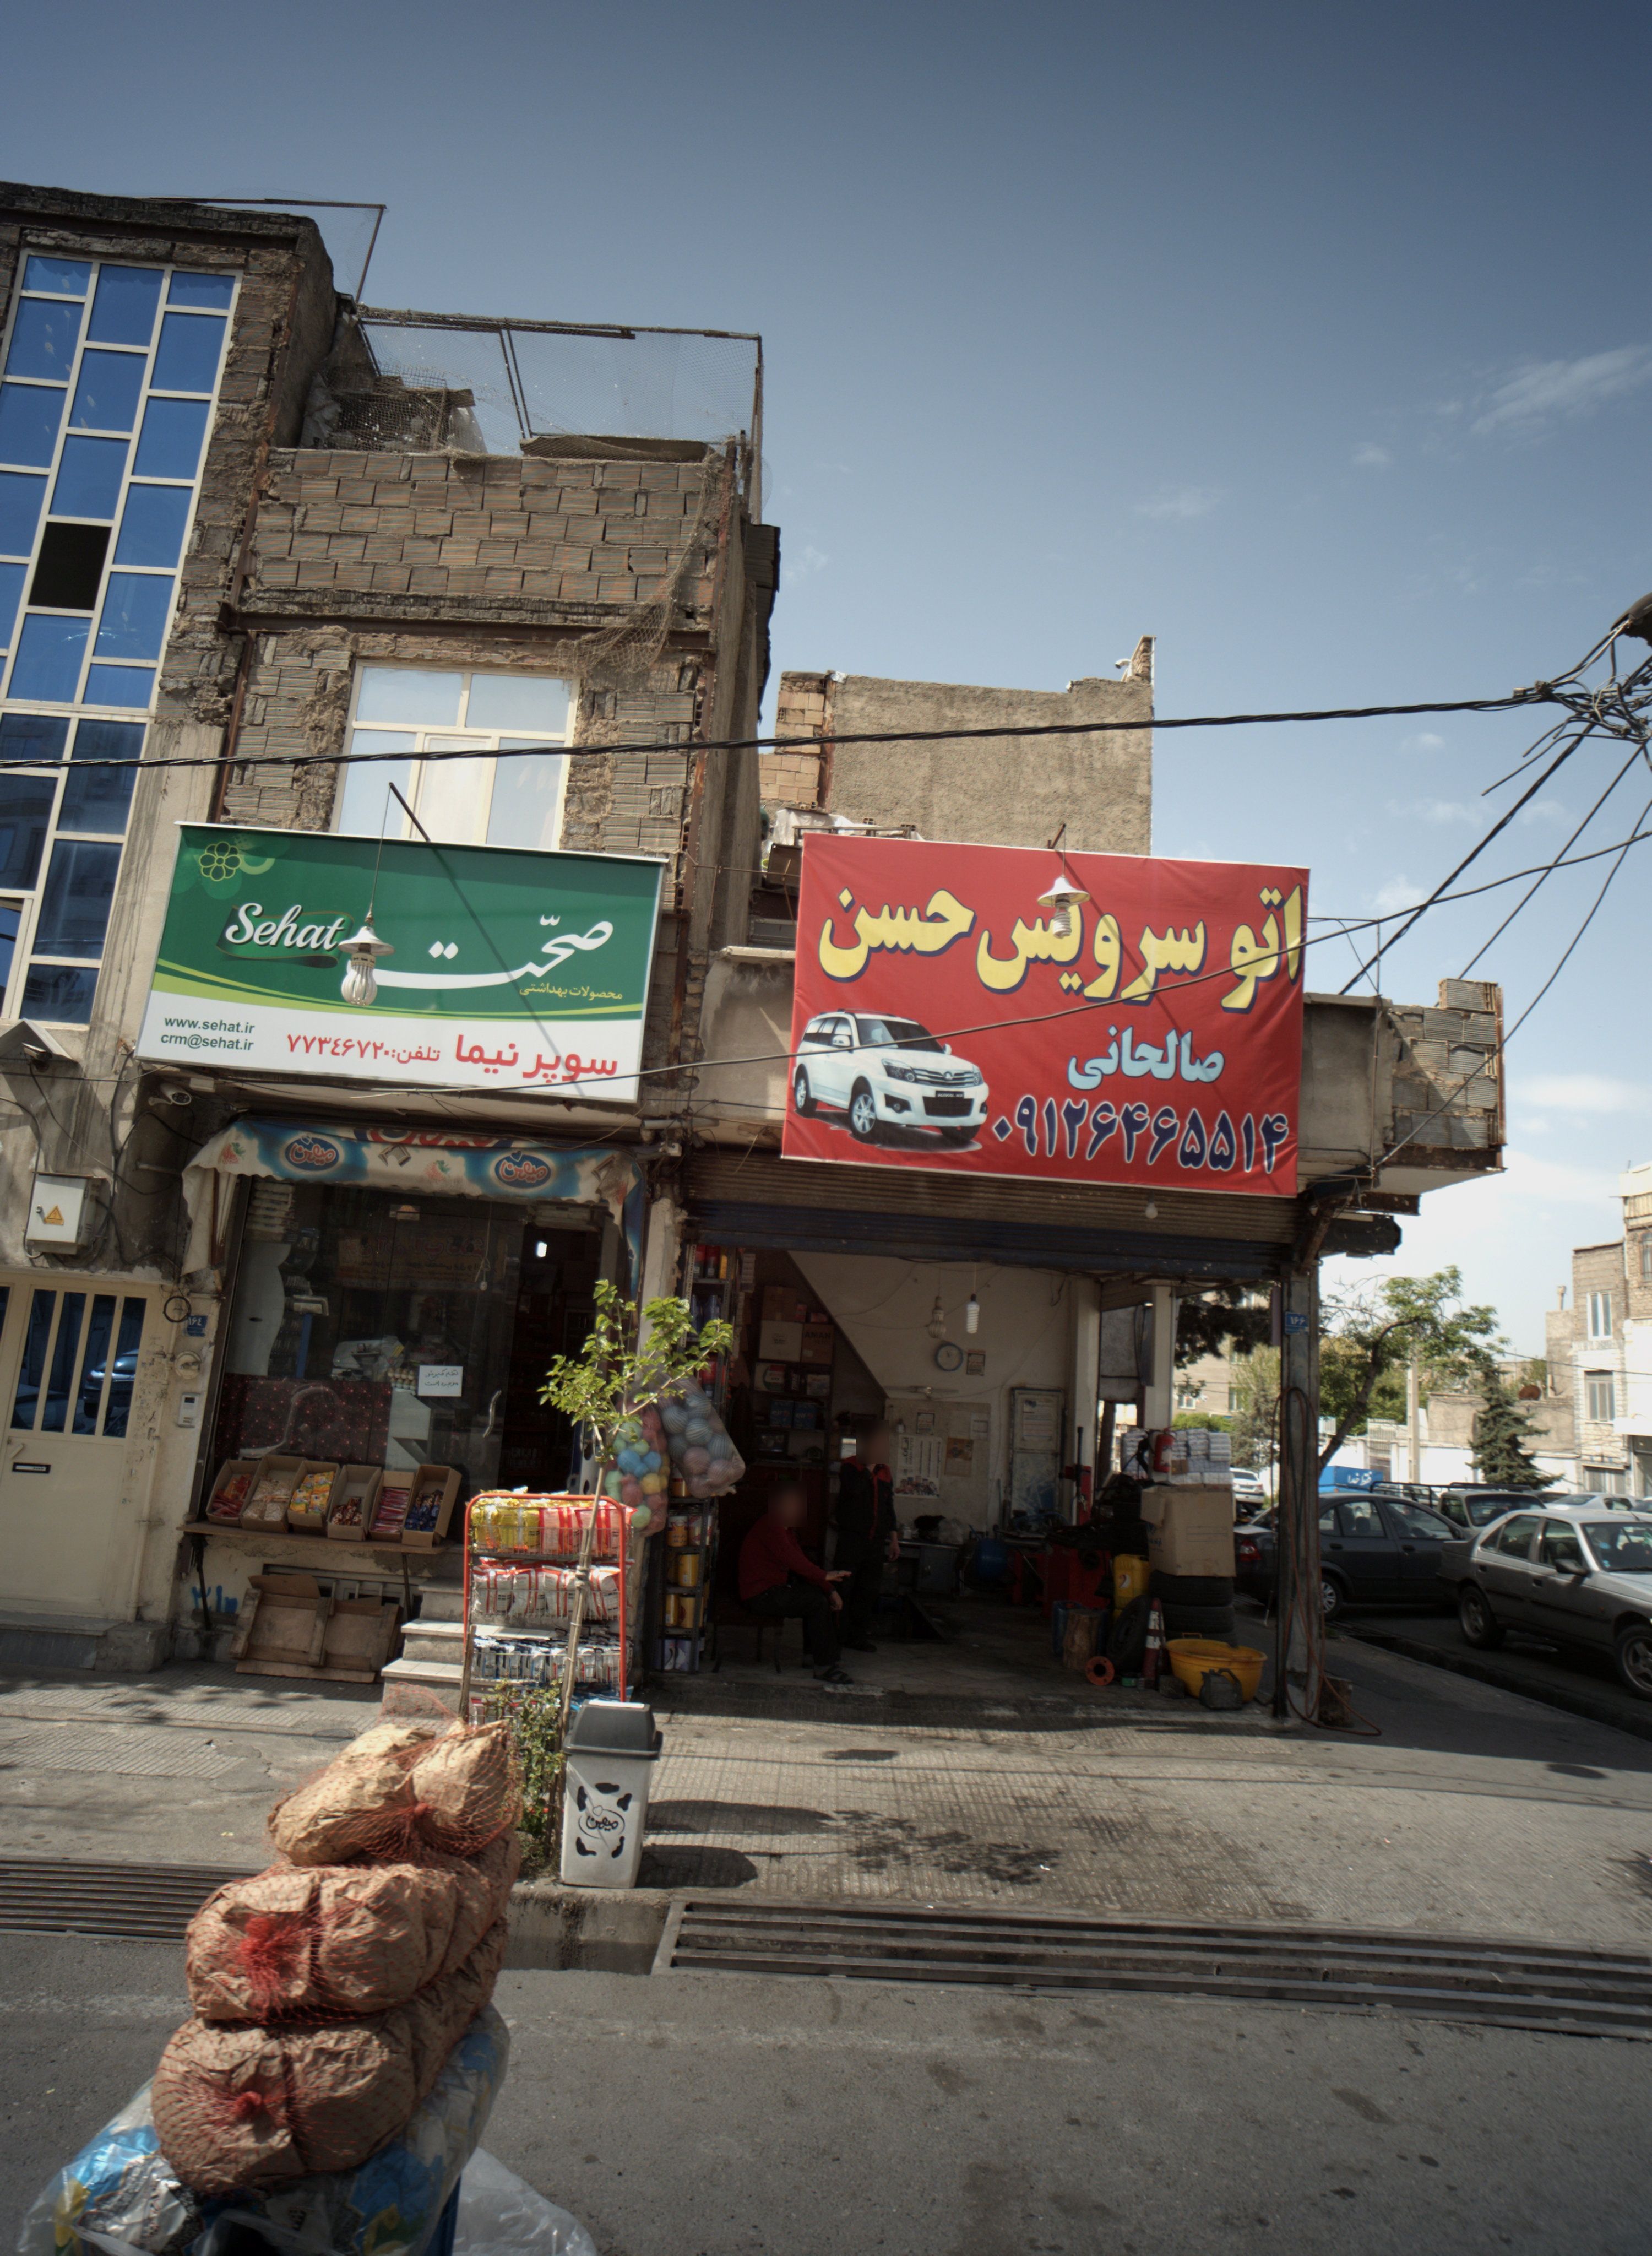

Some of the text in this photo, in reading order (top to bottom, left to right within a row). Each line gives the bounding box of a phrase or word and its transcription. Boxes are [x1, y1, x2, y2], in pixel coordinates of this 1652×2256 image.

[225, 902, 345, 951] Sehat
[818, 886, 978, 984] حسن
[1220, 883, 1304, 1015] اتو
[519, 982, 623, 1001] محصولات بهداشتی
[160, 1033, 254, 1051] crm@sehat.ir
[164, 1017, 256, 1034] www.sehat.ir
[455, 1034, 618, 1083] سوپر نیما
[1067, 1024, 1225, 1091] صالحانی
[290, 1142, 337, 1166] میهن
[992, 1094, 1290, 1175] ۰۹۱۲۶۴۶۵۵۱۴
[499, 1159, 548, 1184] میهن
